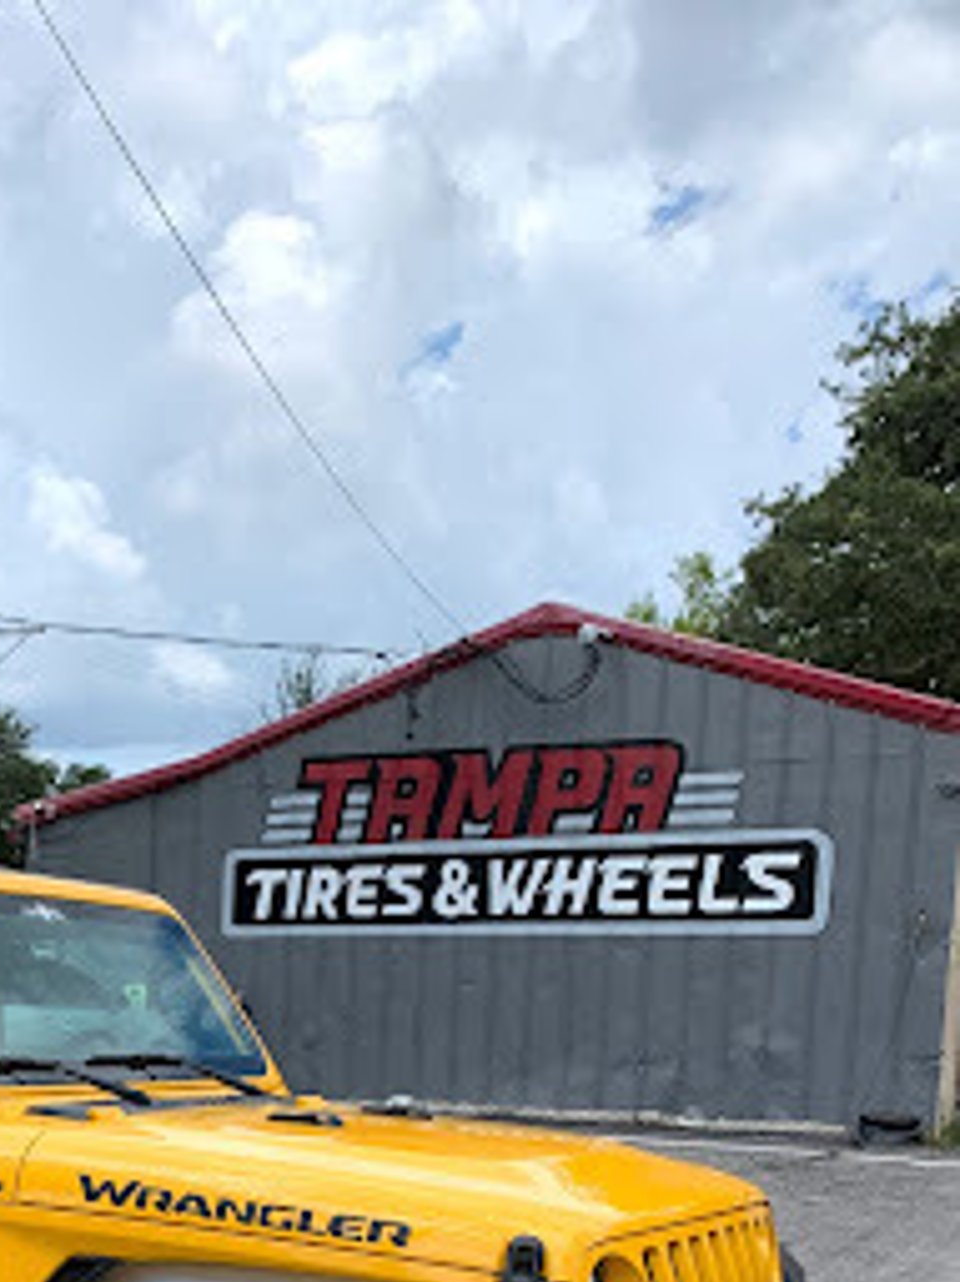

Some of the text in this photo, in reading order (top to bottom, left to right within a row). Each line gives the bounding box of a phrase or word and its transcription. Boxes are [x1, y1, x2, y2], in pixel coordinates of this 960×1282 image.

[301, 742, 682, 845] TAMPA
[245, 863, 426, 921] TIRES
[488, 853, 802, 918] WHEELS
[78, 1174, 413, 1248] WRANGLER
